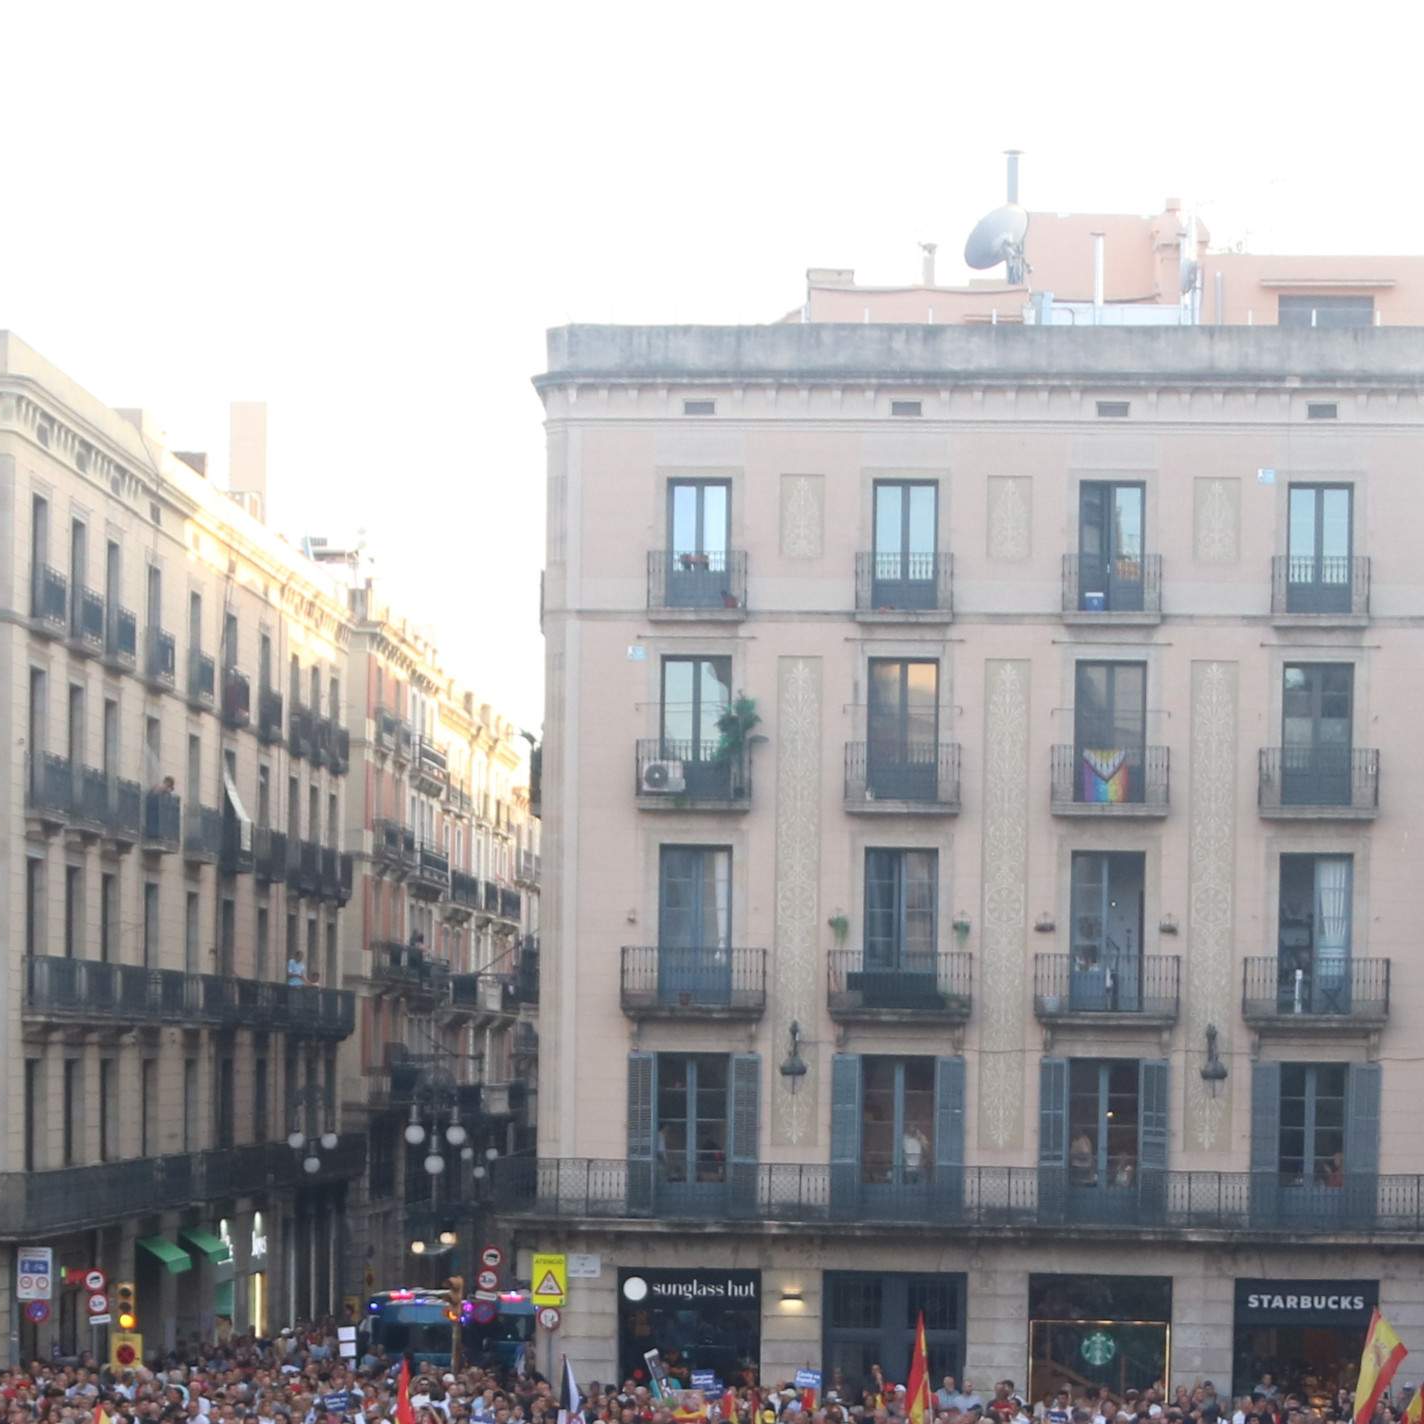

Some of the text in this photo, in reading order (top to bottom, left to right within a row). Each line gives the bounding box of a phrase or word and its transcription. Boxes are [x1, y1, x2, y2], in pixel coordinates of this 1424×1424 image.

[652, 1278, 756, 1299] sunglass hut
[1247, 1294, 1364, 1310] STARBUCKS
